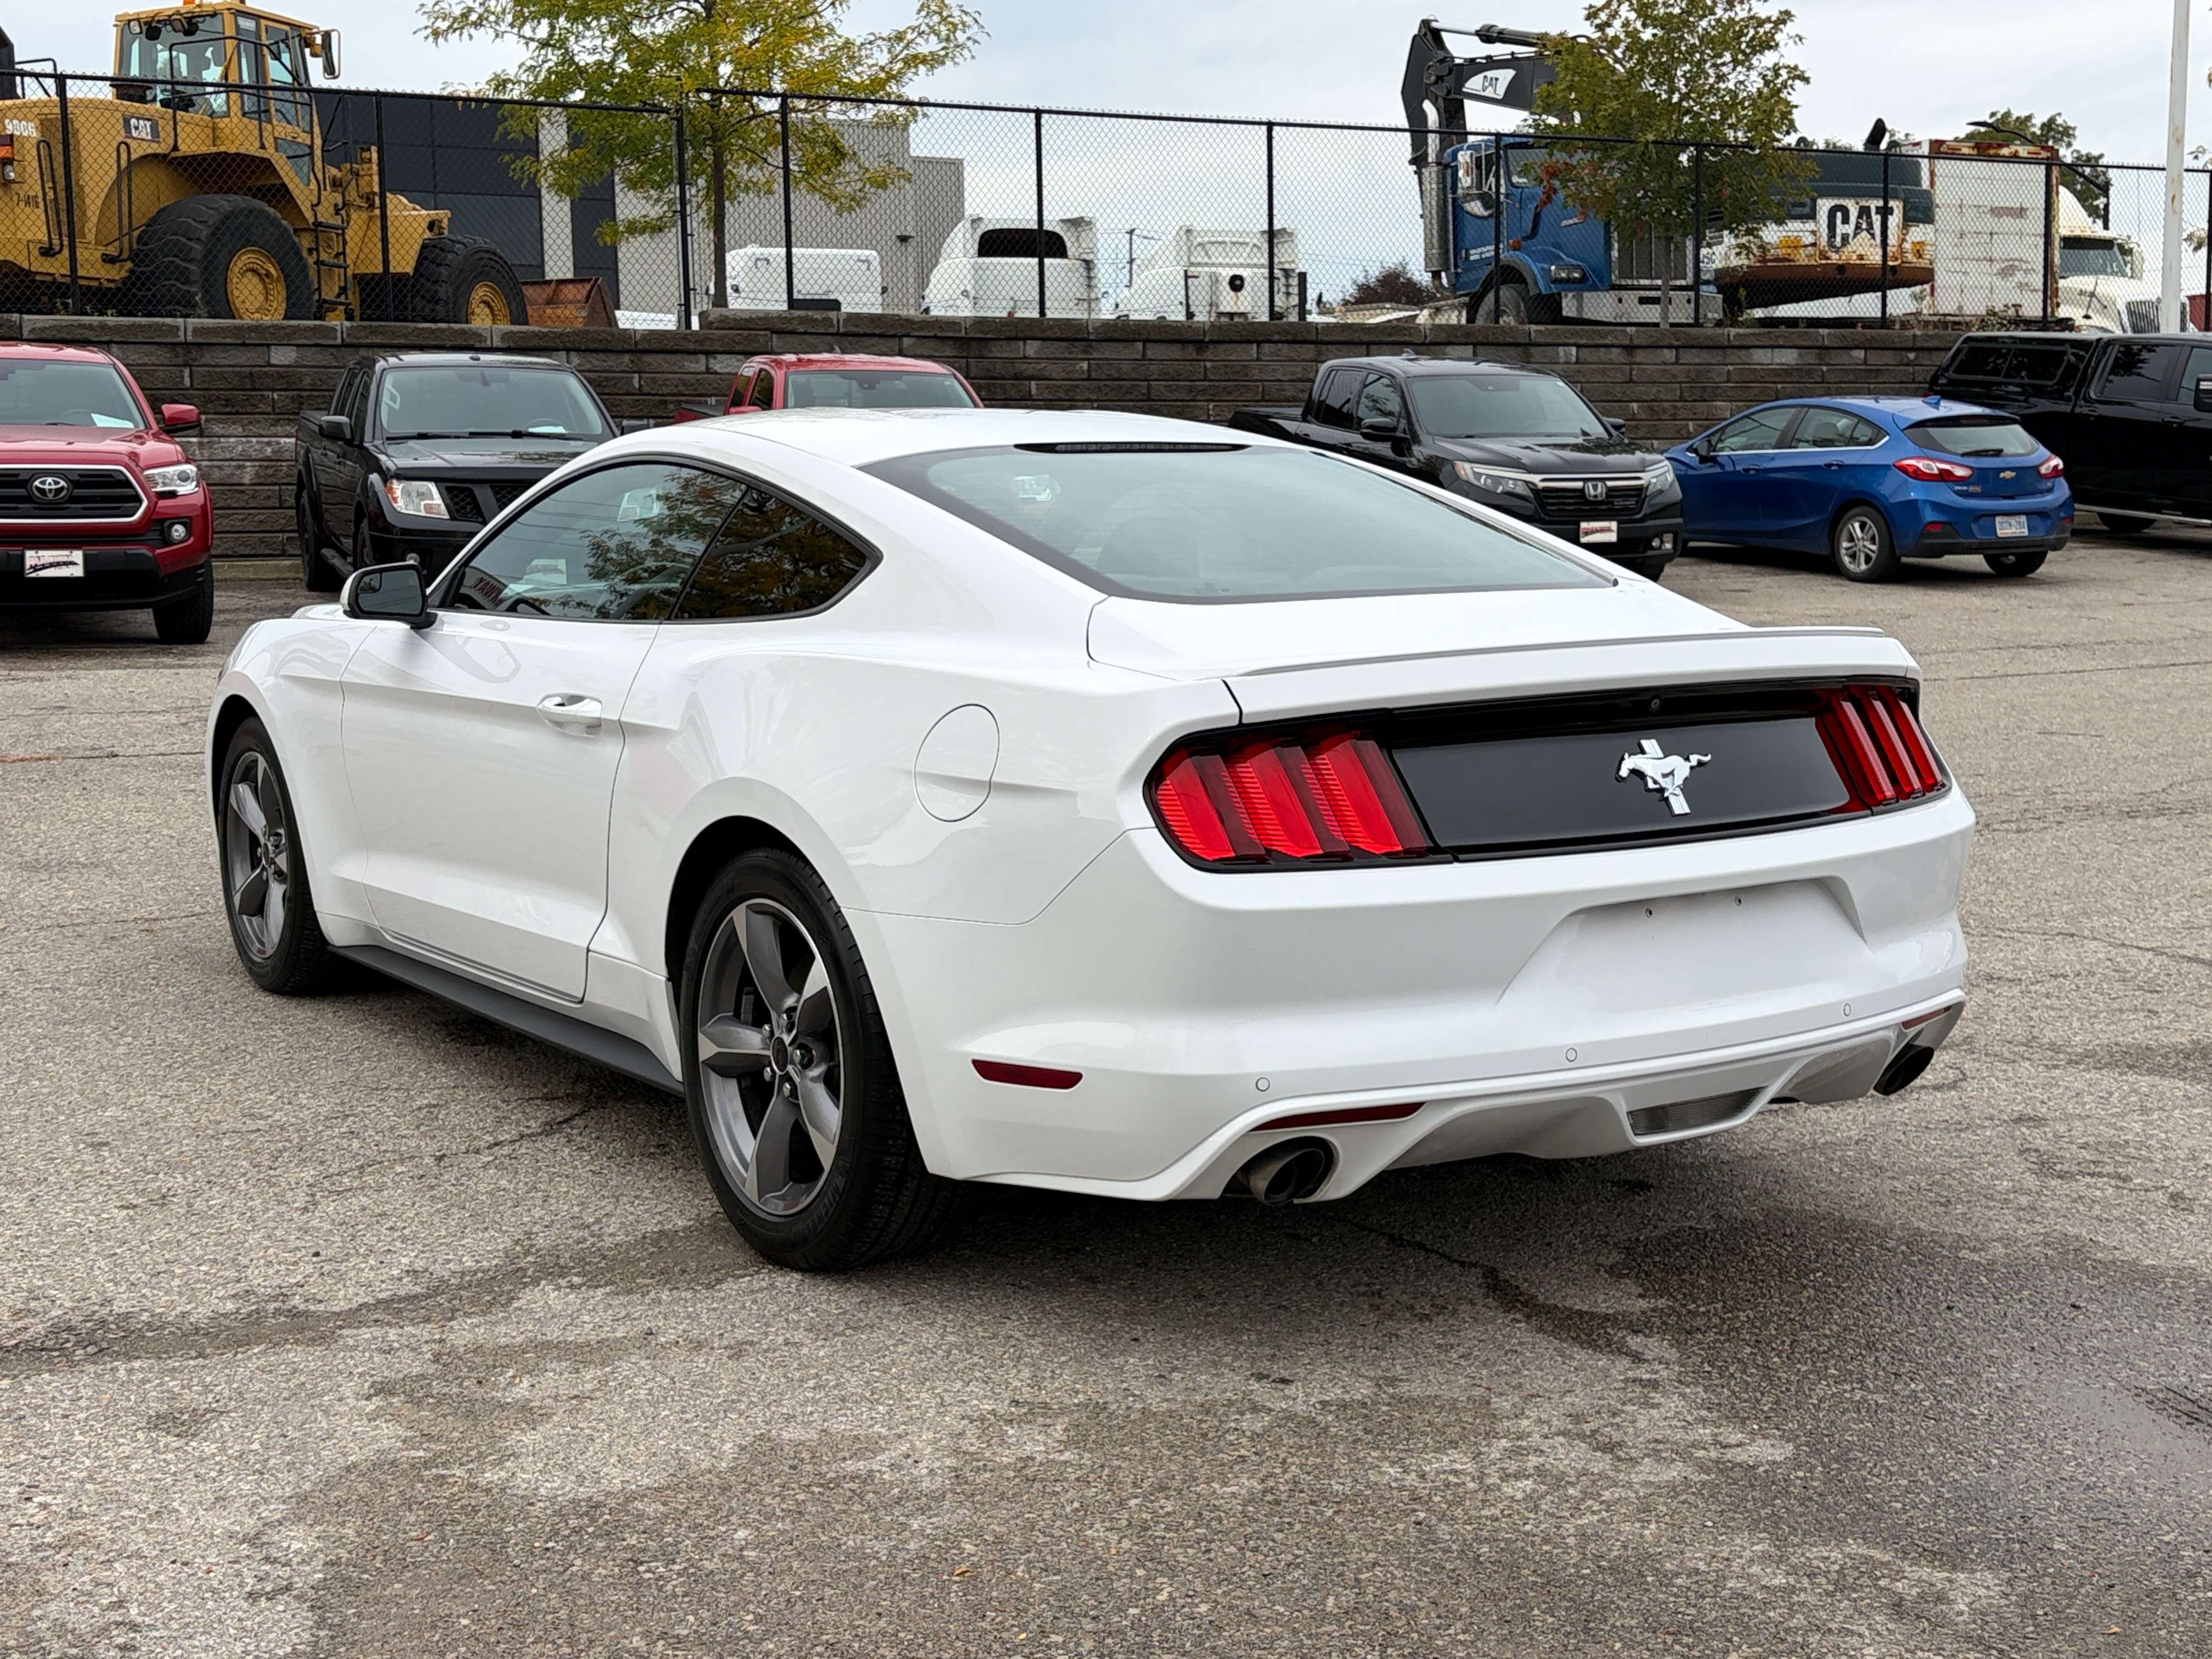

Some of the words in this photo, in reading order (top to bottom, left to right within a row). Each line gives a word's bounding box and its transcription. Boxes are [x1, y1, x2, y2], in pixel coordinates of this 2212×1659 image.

[1482, 75, 1501, 95] CAT
[130, 118, 152, 140] CAT
[1827, 204, 1894, 252] CAT
